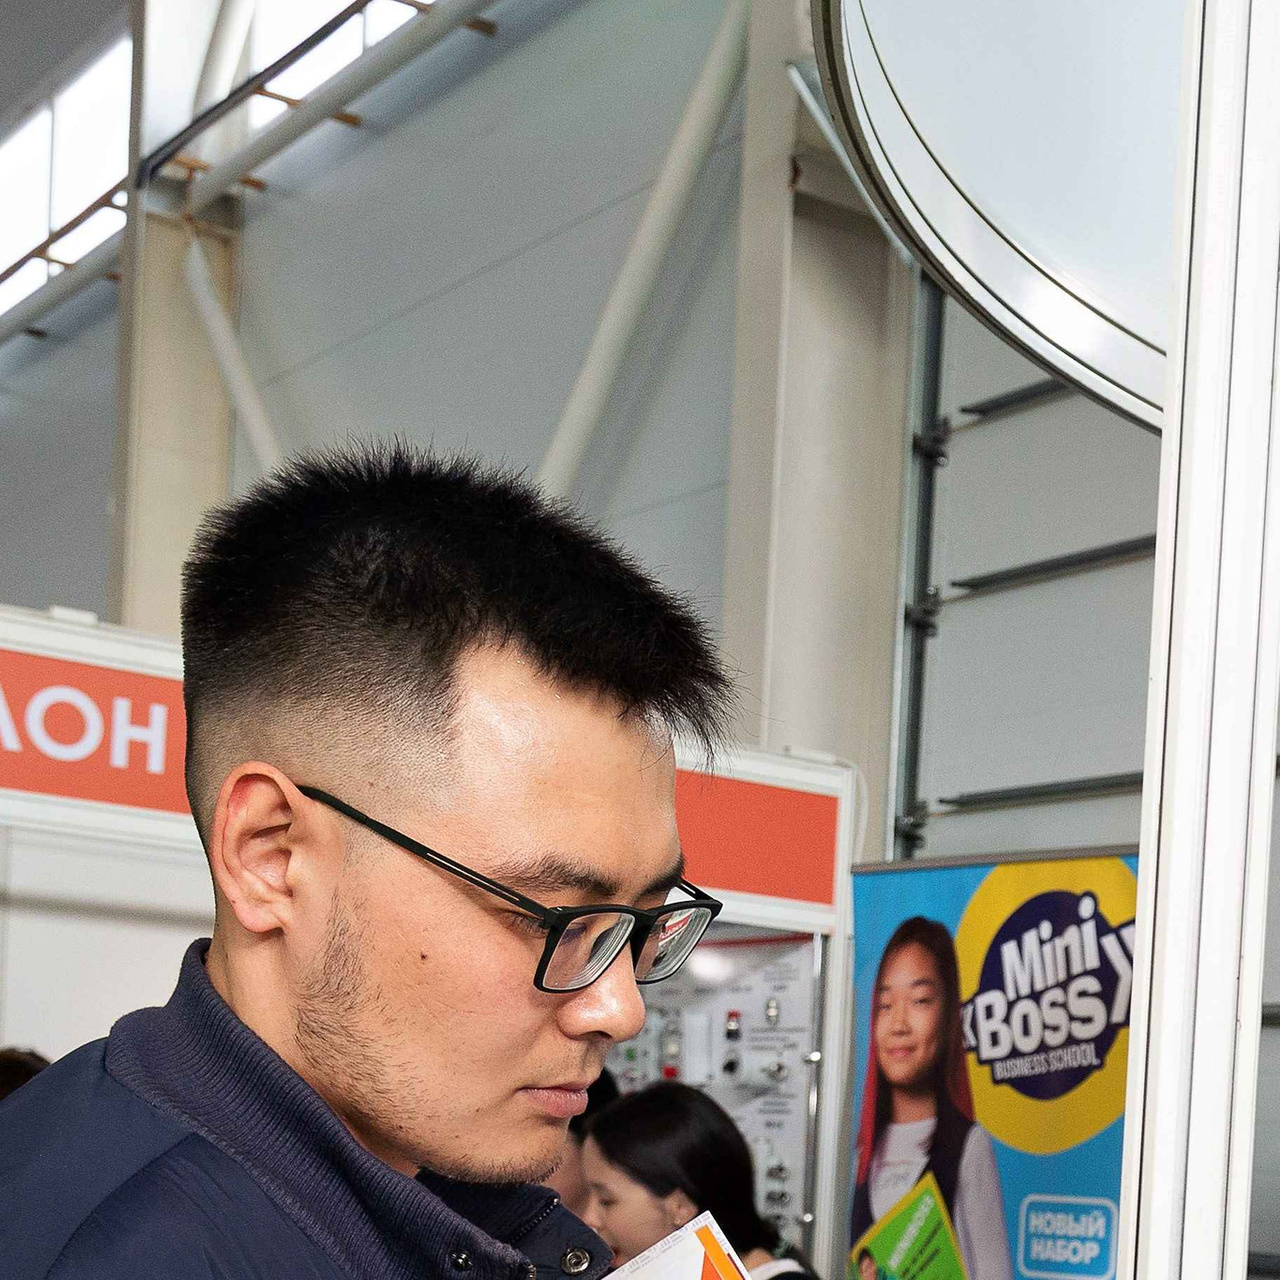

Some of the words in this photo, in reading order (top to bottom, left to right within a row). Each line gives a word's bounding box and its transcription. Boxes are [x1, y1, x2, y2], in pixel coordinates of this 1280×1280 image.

[1001, 895, 1101, 1002] Mini
[974, 974, 1108, 1061] Boss
[1049, 1041, 1101, 1072] SCHOOL
[1028, 1210, 1107, 1239] НОВЫЙ
[1029, 1237, 1101, 1266] НАБОР
